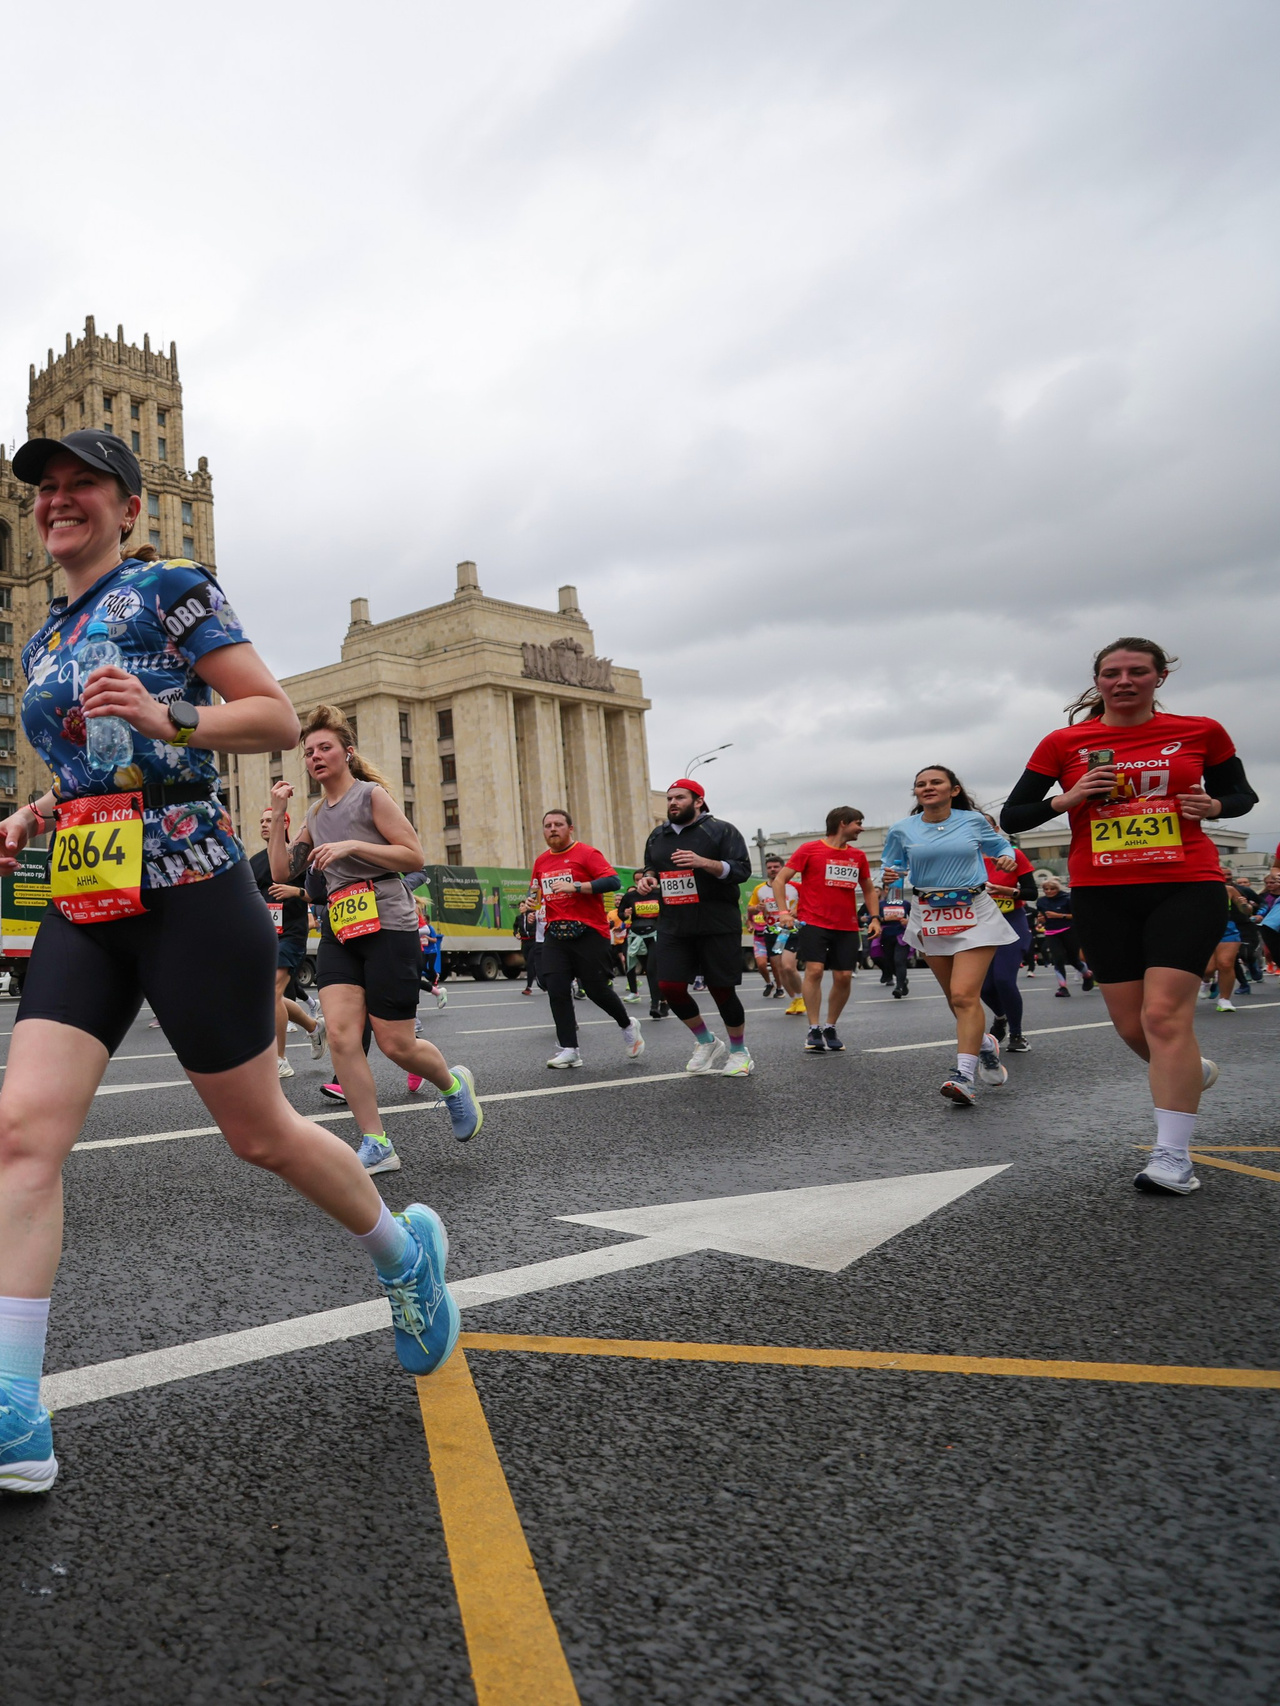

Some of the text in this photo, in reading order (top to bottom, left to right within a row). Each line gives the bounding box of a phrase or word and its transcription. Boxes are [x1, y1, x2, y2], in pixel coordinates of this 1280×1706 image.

[165, 597, 208, 641] ОВО
[1116, 759, 1170, 770] РАФОН
[91, 811, 107, 823] 10
[1094, 816, 1174, 841] 21431
[57, 828, 126, 873] 2864
[1099, 853, 1113, 865] G
[828, 866, 858, 878] 13876
[76, 875, 99, 887] АННА
[662, 878, 695, 891] 18816
[332, 895, 368, 923] 3786
[993, 898, 1012, 908] 79
[60, 901, 73, 921] G
[922, 907, 975, 922] 27506
